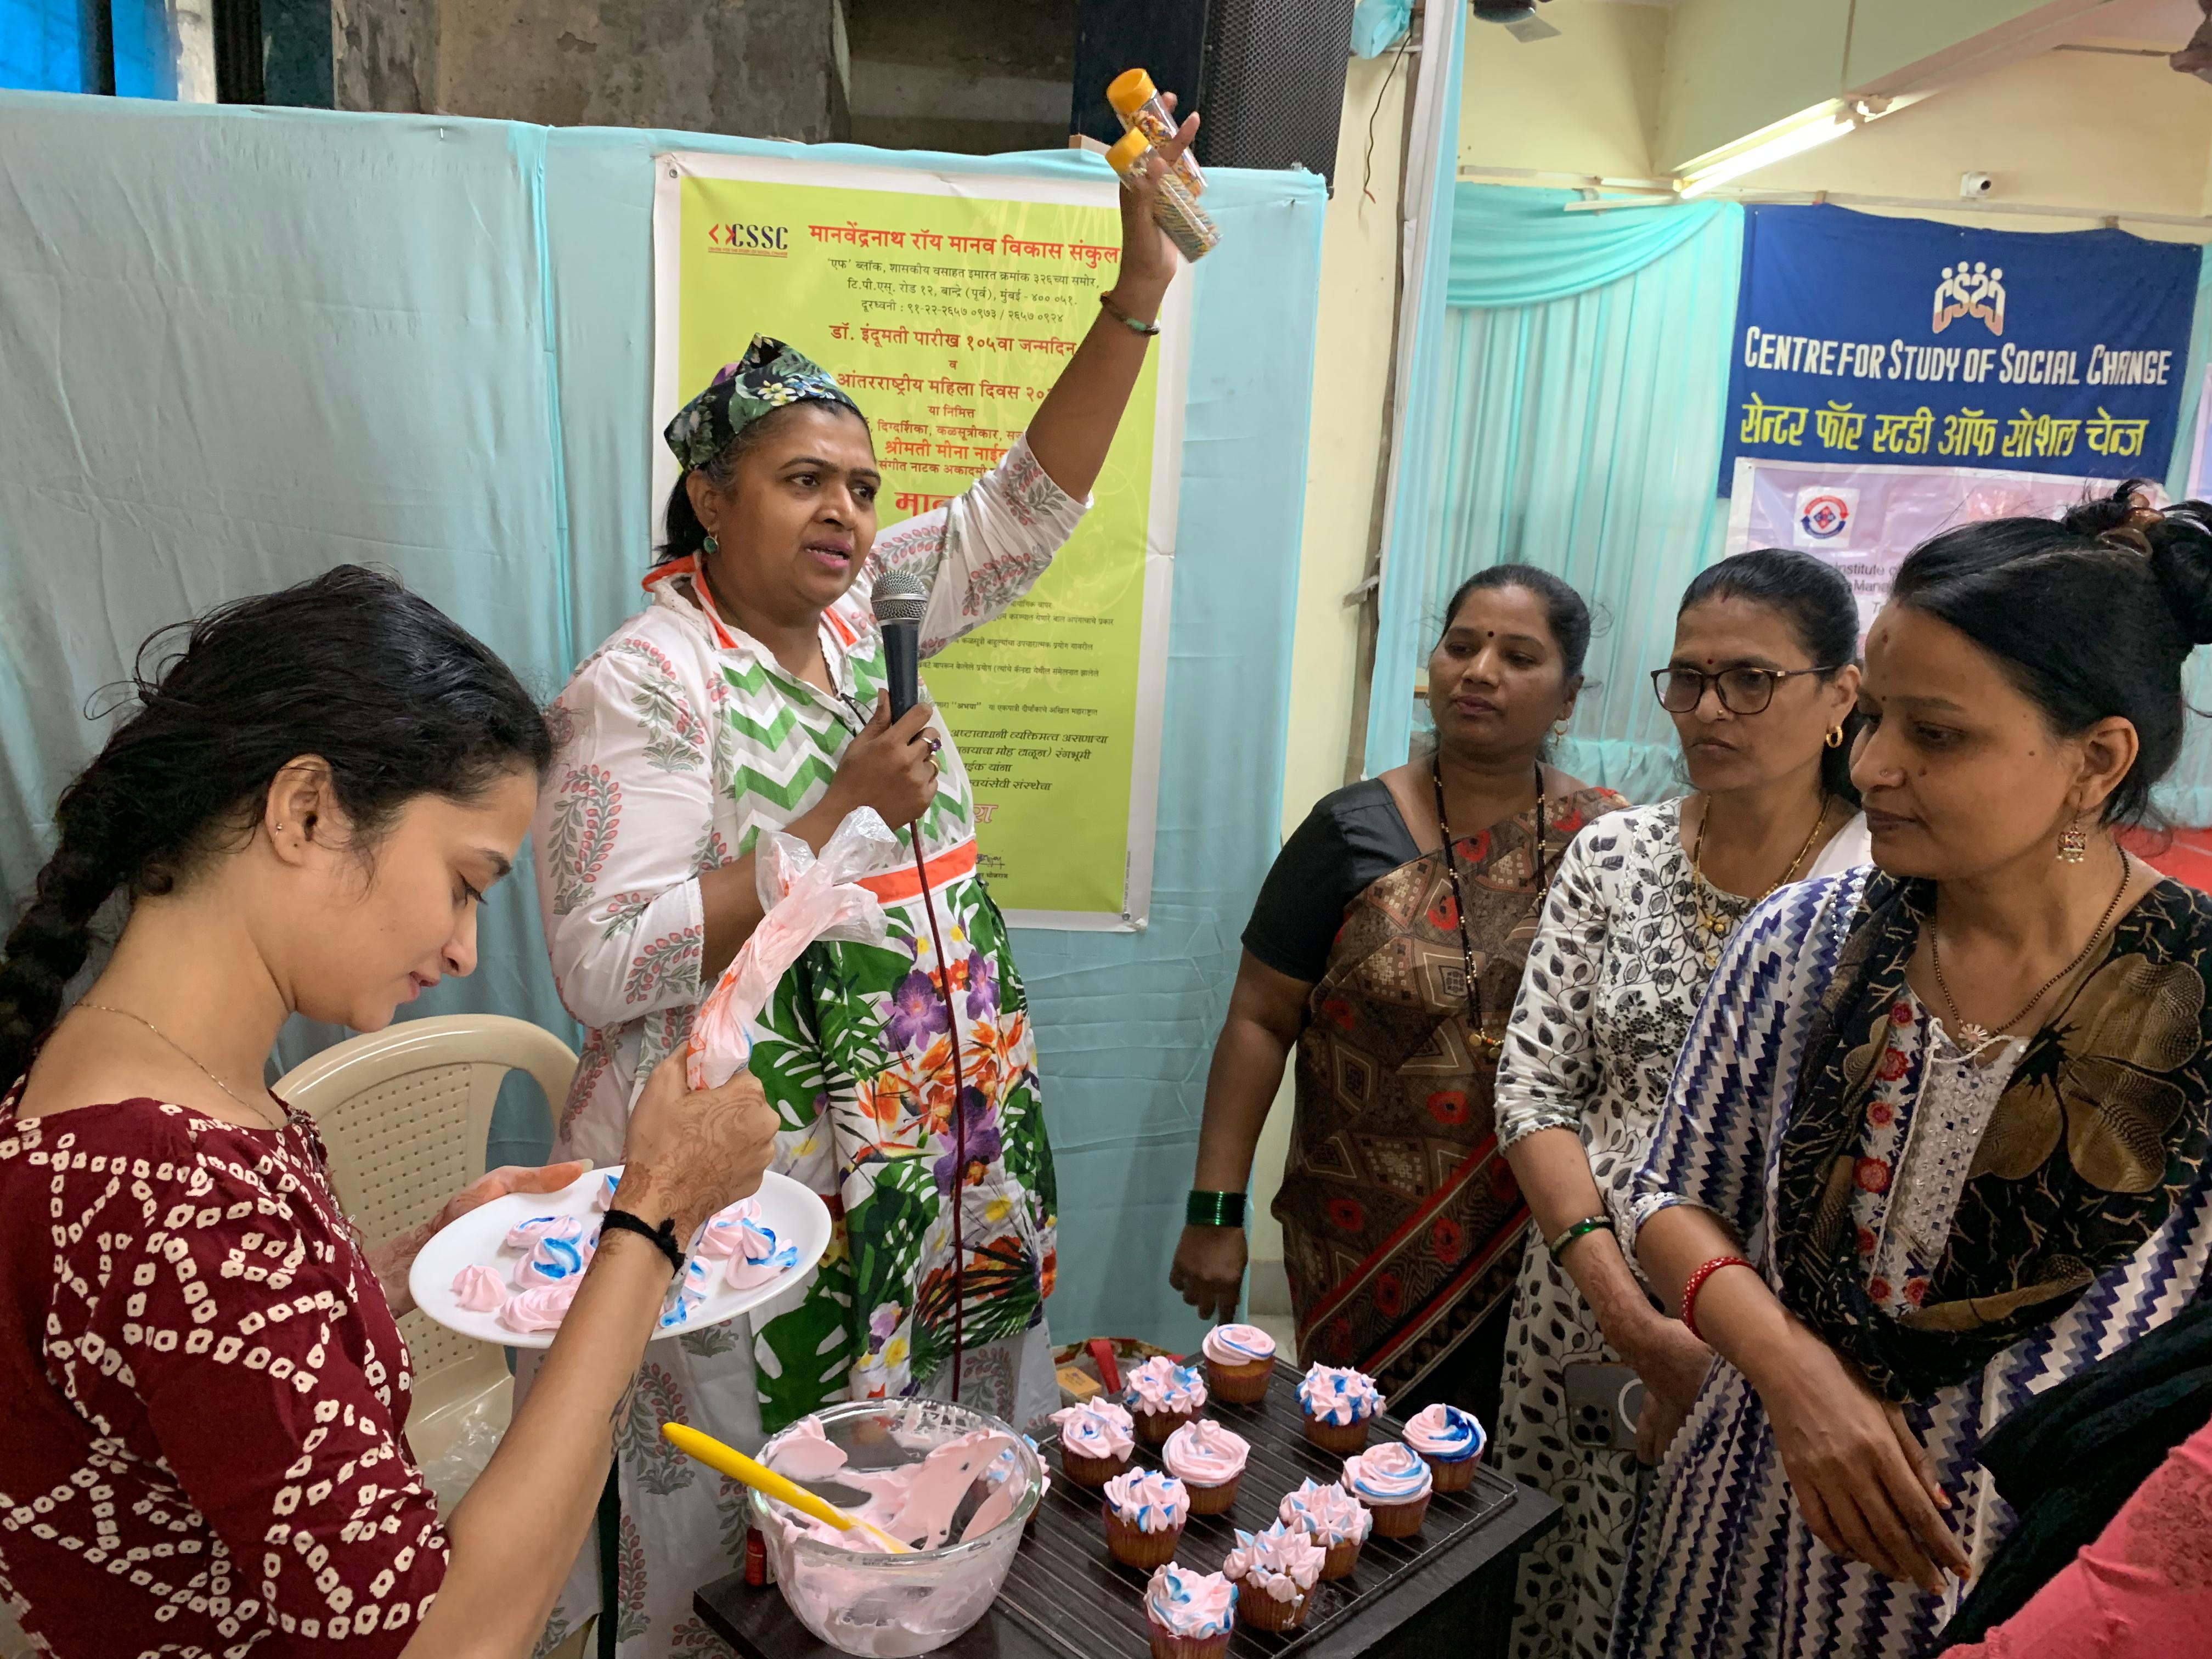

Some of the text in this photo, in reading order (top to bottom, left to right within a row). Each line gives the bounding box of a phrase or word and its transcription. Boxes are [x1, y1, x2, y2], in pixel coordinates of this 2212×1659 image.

[732, 223, 788, 250] CSSC
[808, 221, 1121, 269] मानवेंद्रनाथ रॉय मानव विकास संकुल
[856, 258, 886, 274] ब्लॉक,
[889, 261, 930, 275] शासकीय
[933, 267, 966, 279] वसाहत
[968, 268, 997, 281] इमारत
[1000, 269, 1030, 282] क्रमांक
[1034, 274, 1069, 285] ३२६च्या
[1071, 274, 1099, 289] समोर,
[899, 280, 917, 293] रोड
[921, 285, 937, 297] १२,
[941, 284, 962, 298] बान्द्रे
[966, 287, 996, 302] (पूर्व),
[1000, 289, 1023, 303] मुंबई
[1031, 293, 1050, 303] ४००
[861, 300, 897, 313] दूरध्वनी
[971, 308, 997, 319] ०९७३
[1008, 309, 1034, 321] २६५७
[1037, 313, 1063, 324] ०९२४
[829, 322, 1077, 356] डॉ. इंदूमती पारीख १०५वा जन्मदिन
[949, 360, 958, 370] व
[1745, 326, 2172, 385] CENTRE FOR STUDY OF SOCIAL CHANGE
[837, 370, 1053, 403] आंतरराष्ट्रीय महिला दिवस २०
[927, 404, 976, 419] या निमित्त
[877, 419, 932, 437] दिग्दर्शिका,
[936, 425, 1002, 441] कळसूत्रीकार,
[1740, 392, 2151, 458] सेन्टर फॉर स्टडी ऑफ सोशल चेन्ज
[885, 437, 932, 457] श्रीमती
[935, 440, 969, 460] मीना
[878, 458, 988, 476] संगीत नाटक अकादमी
[996, 745, 1016, 757] मोह
[1056, 747, 1092, 761] रंगभूमी
[988, 761, 1013, 772] यांना
[1013, 779, 1053, 791] संस्थेचा
